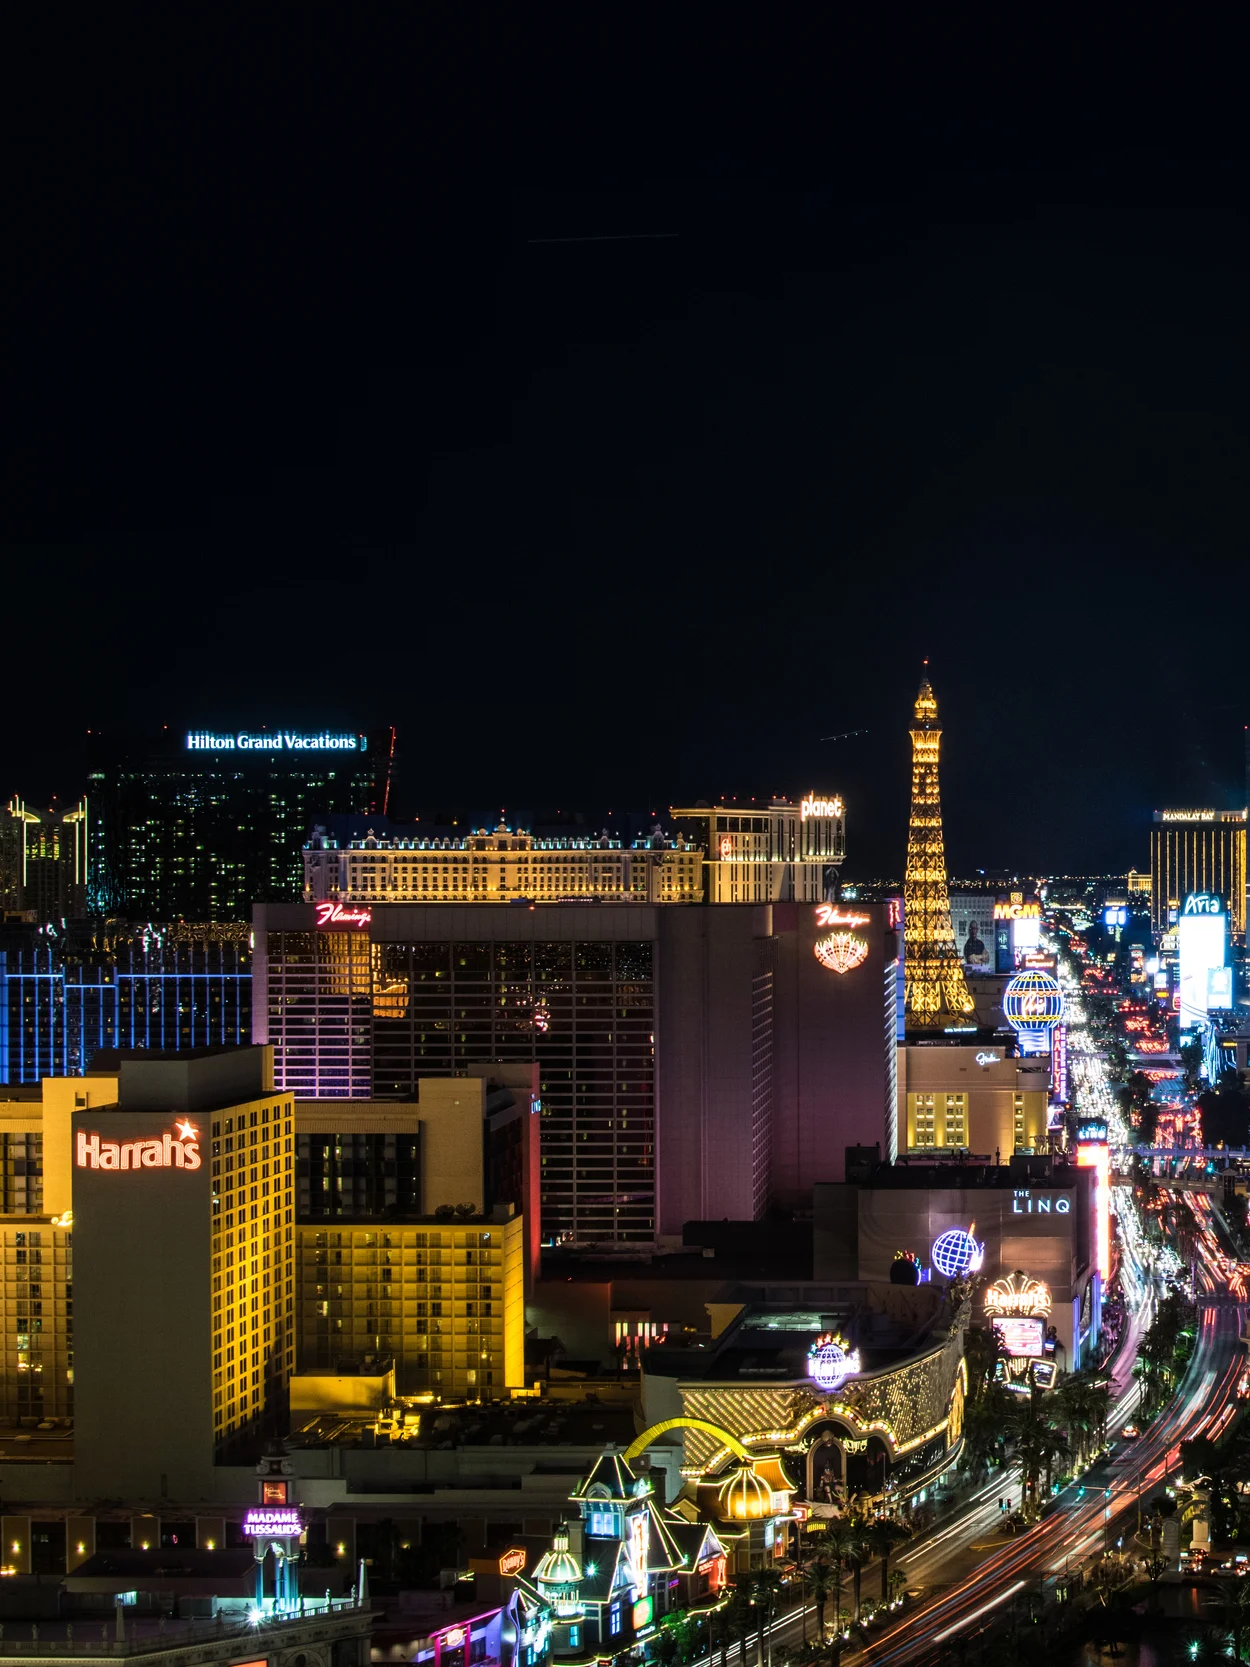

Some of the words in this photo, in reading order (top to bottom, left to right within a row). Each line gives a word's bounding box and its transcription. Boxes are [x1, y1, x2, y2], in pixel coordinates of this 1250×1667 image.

[187, 735, 235, 749] Hilton
[237, 735, 283, 749] Grand
[284, 735, 357, 749] Vacations
[801, 794, 842, 822] planet
[1162, 813, 1200, 821] MANDALAY
[993, 904, 1039, 920] MGM
[1184, 895, 1220, 915] Aria
[1013, 1190, 1030, 1198] THE
[1013, 1199, 1070, 1213] LINQ
[247, 1513, 299, 1523] MADAME
